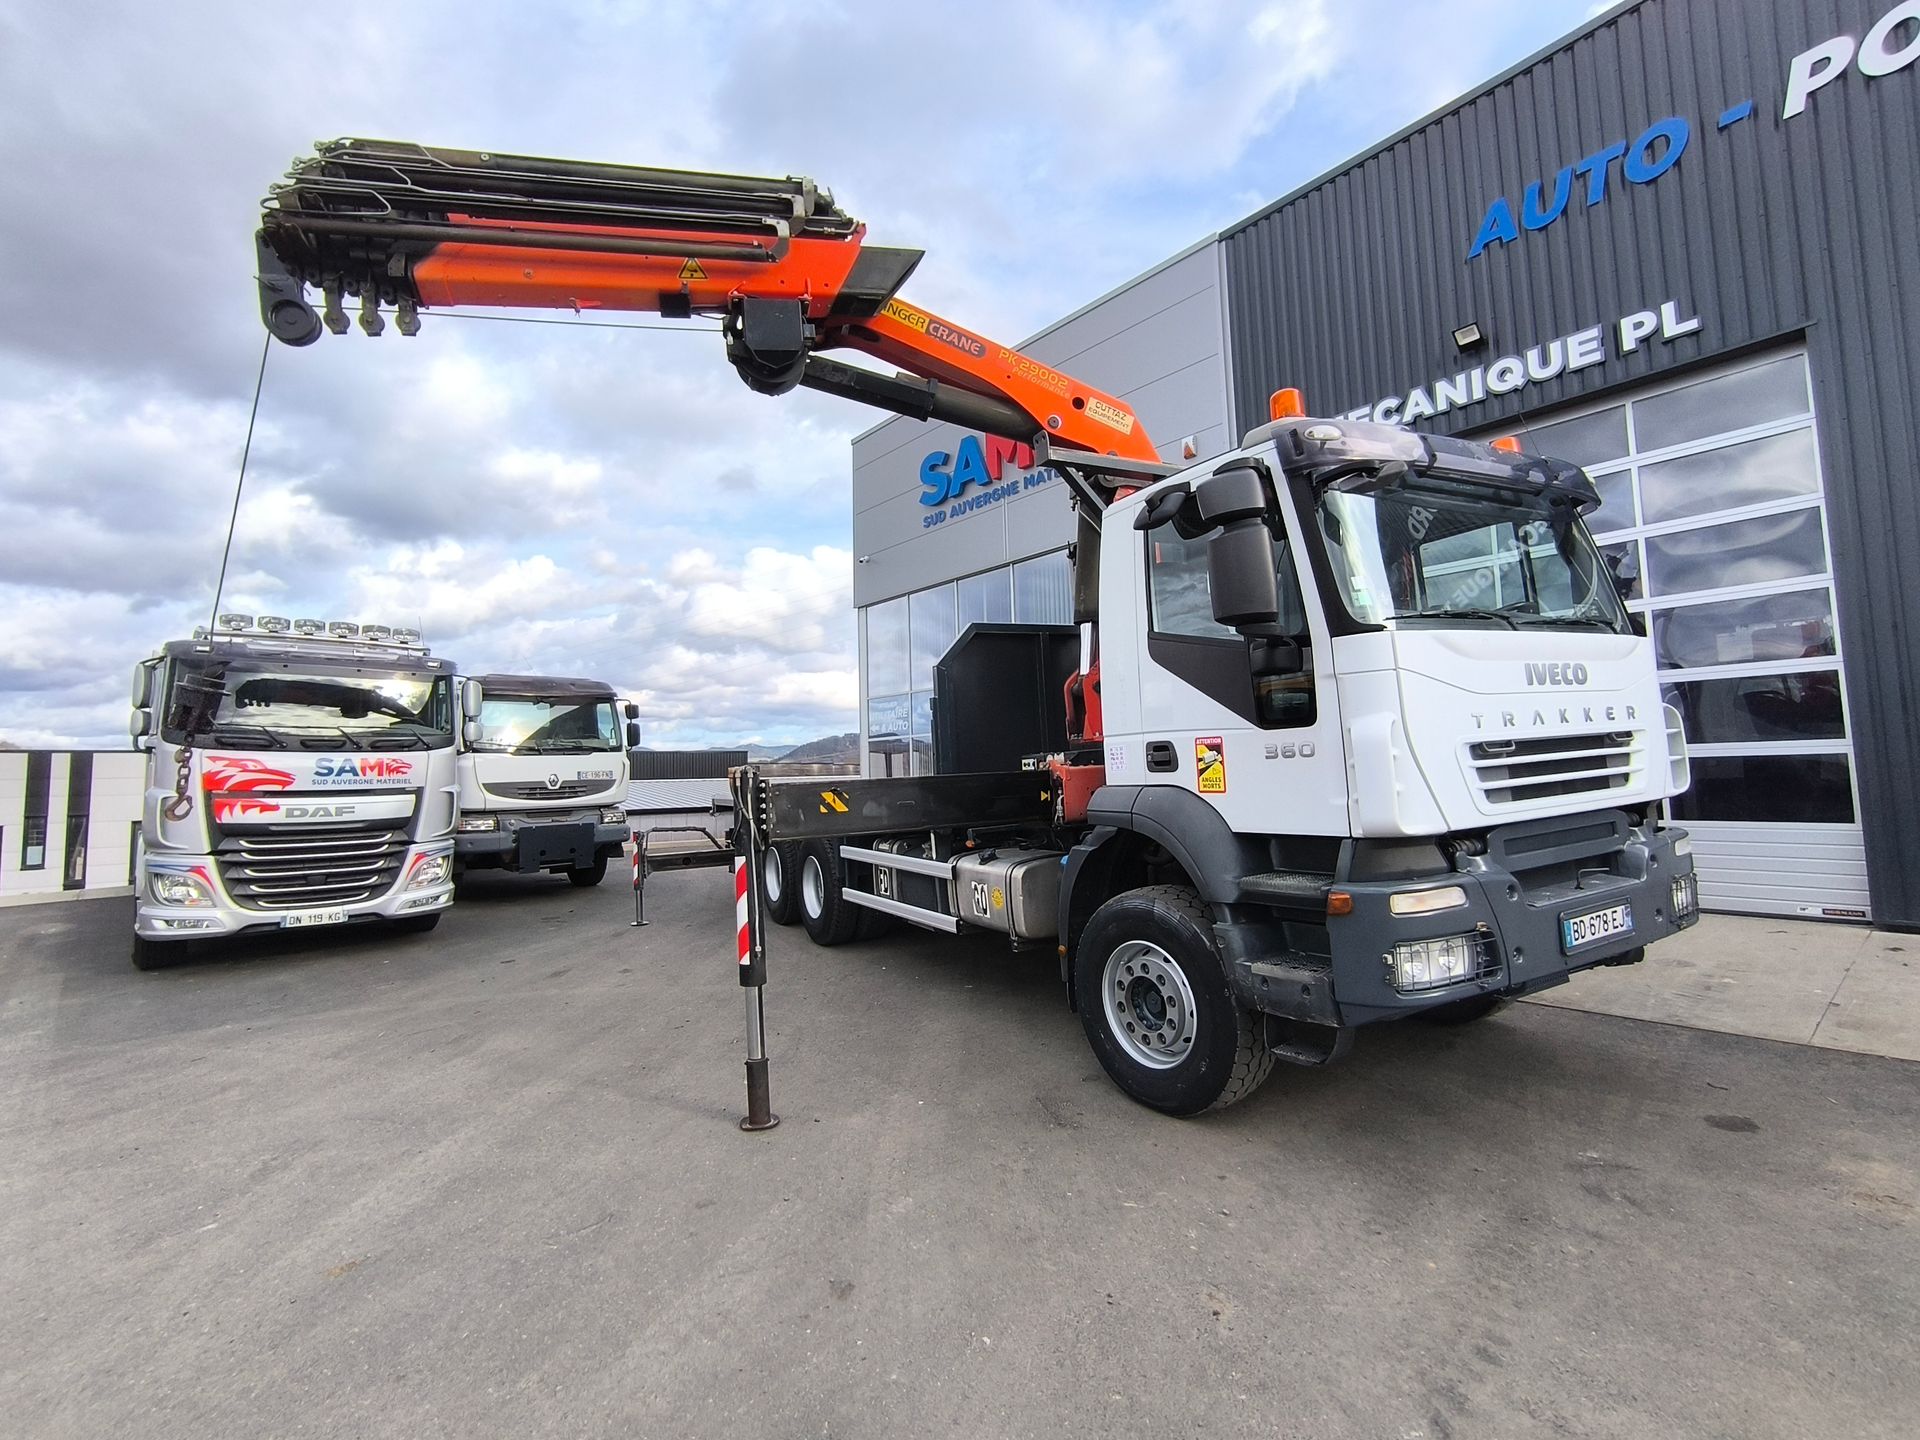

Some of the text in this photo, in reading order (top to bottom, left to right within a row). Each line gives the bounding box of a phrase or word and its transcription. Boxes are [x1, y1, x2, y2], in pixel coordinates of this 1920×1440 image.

[1467, 117, 1689, 260] AUTO
[883, 302, 982, 355] NGER CRANE
[998, 349, 1069, 390] PK 29002
[1335, 300, 1699, 426] CANIQUE PL
[1094, 401, 1127, 421] CUTTAZ
[919, 432, 1035, 506] SAM
[923, 510, 947, 528] SUD
[950, 480, 1020, 518] AUVERGNE
[1525, 662, 1588, 686] IVECO
[1471, 705, 1636, 729] TRAKKER
[312, 757, 384, 777] SAM
[1264, 742, 1316, 760] 360
[285, 806, 355, 818] DAF
